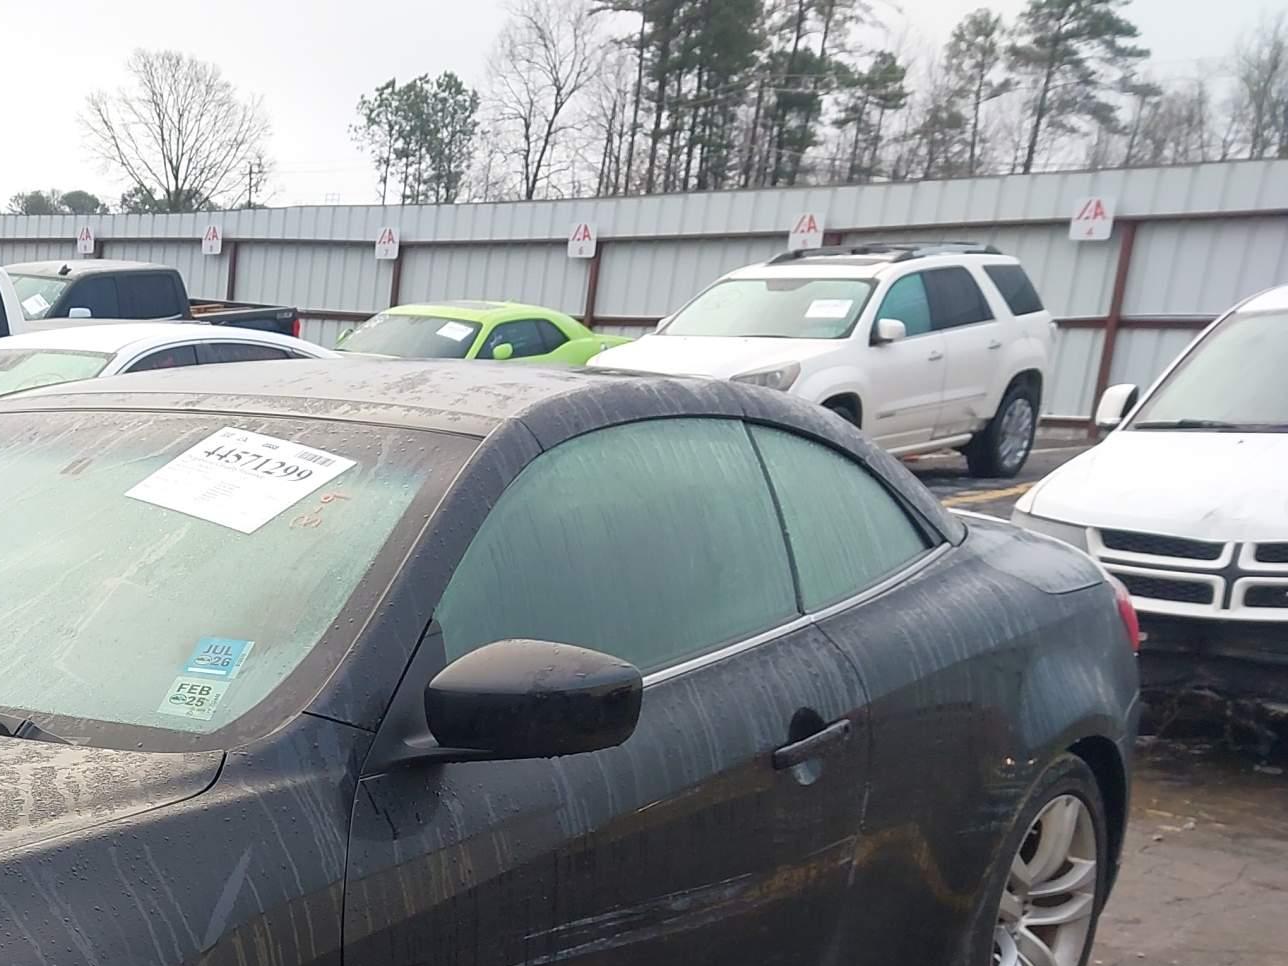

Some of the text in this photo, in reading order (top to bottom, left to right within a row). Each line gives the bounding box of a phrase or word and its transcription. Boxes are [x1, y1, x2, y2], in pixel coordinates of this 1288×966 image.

[202, 444, 314, 482] 44571299
[202, 644, 233, 656] JUL
[209, 656, 232, 667] 26
[176, 682, 212, 696] FEB
[184, 696, 206, 707] 25
